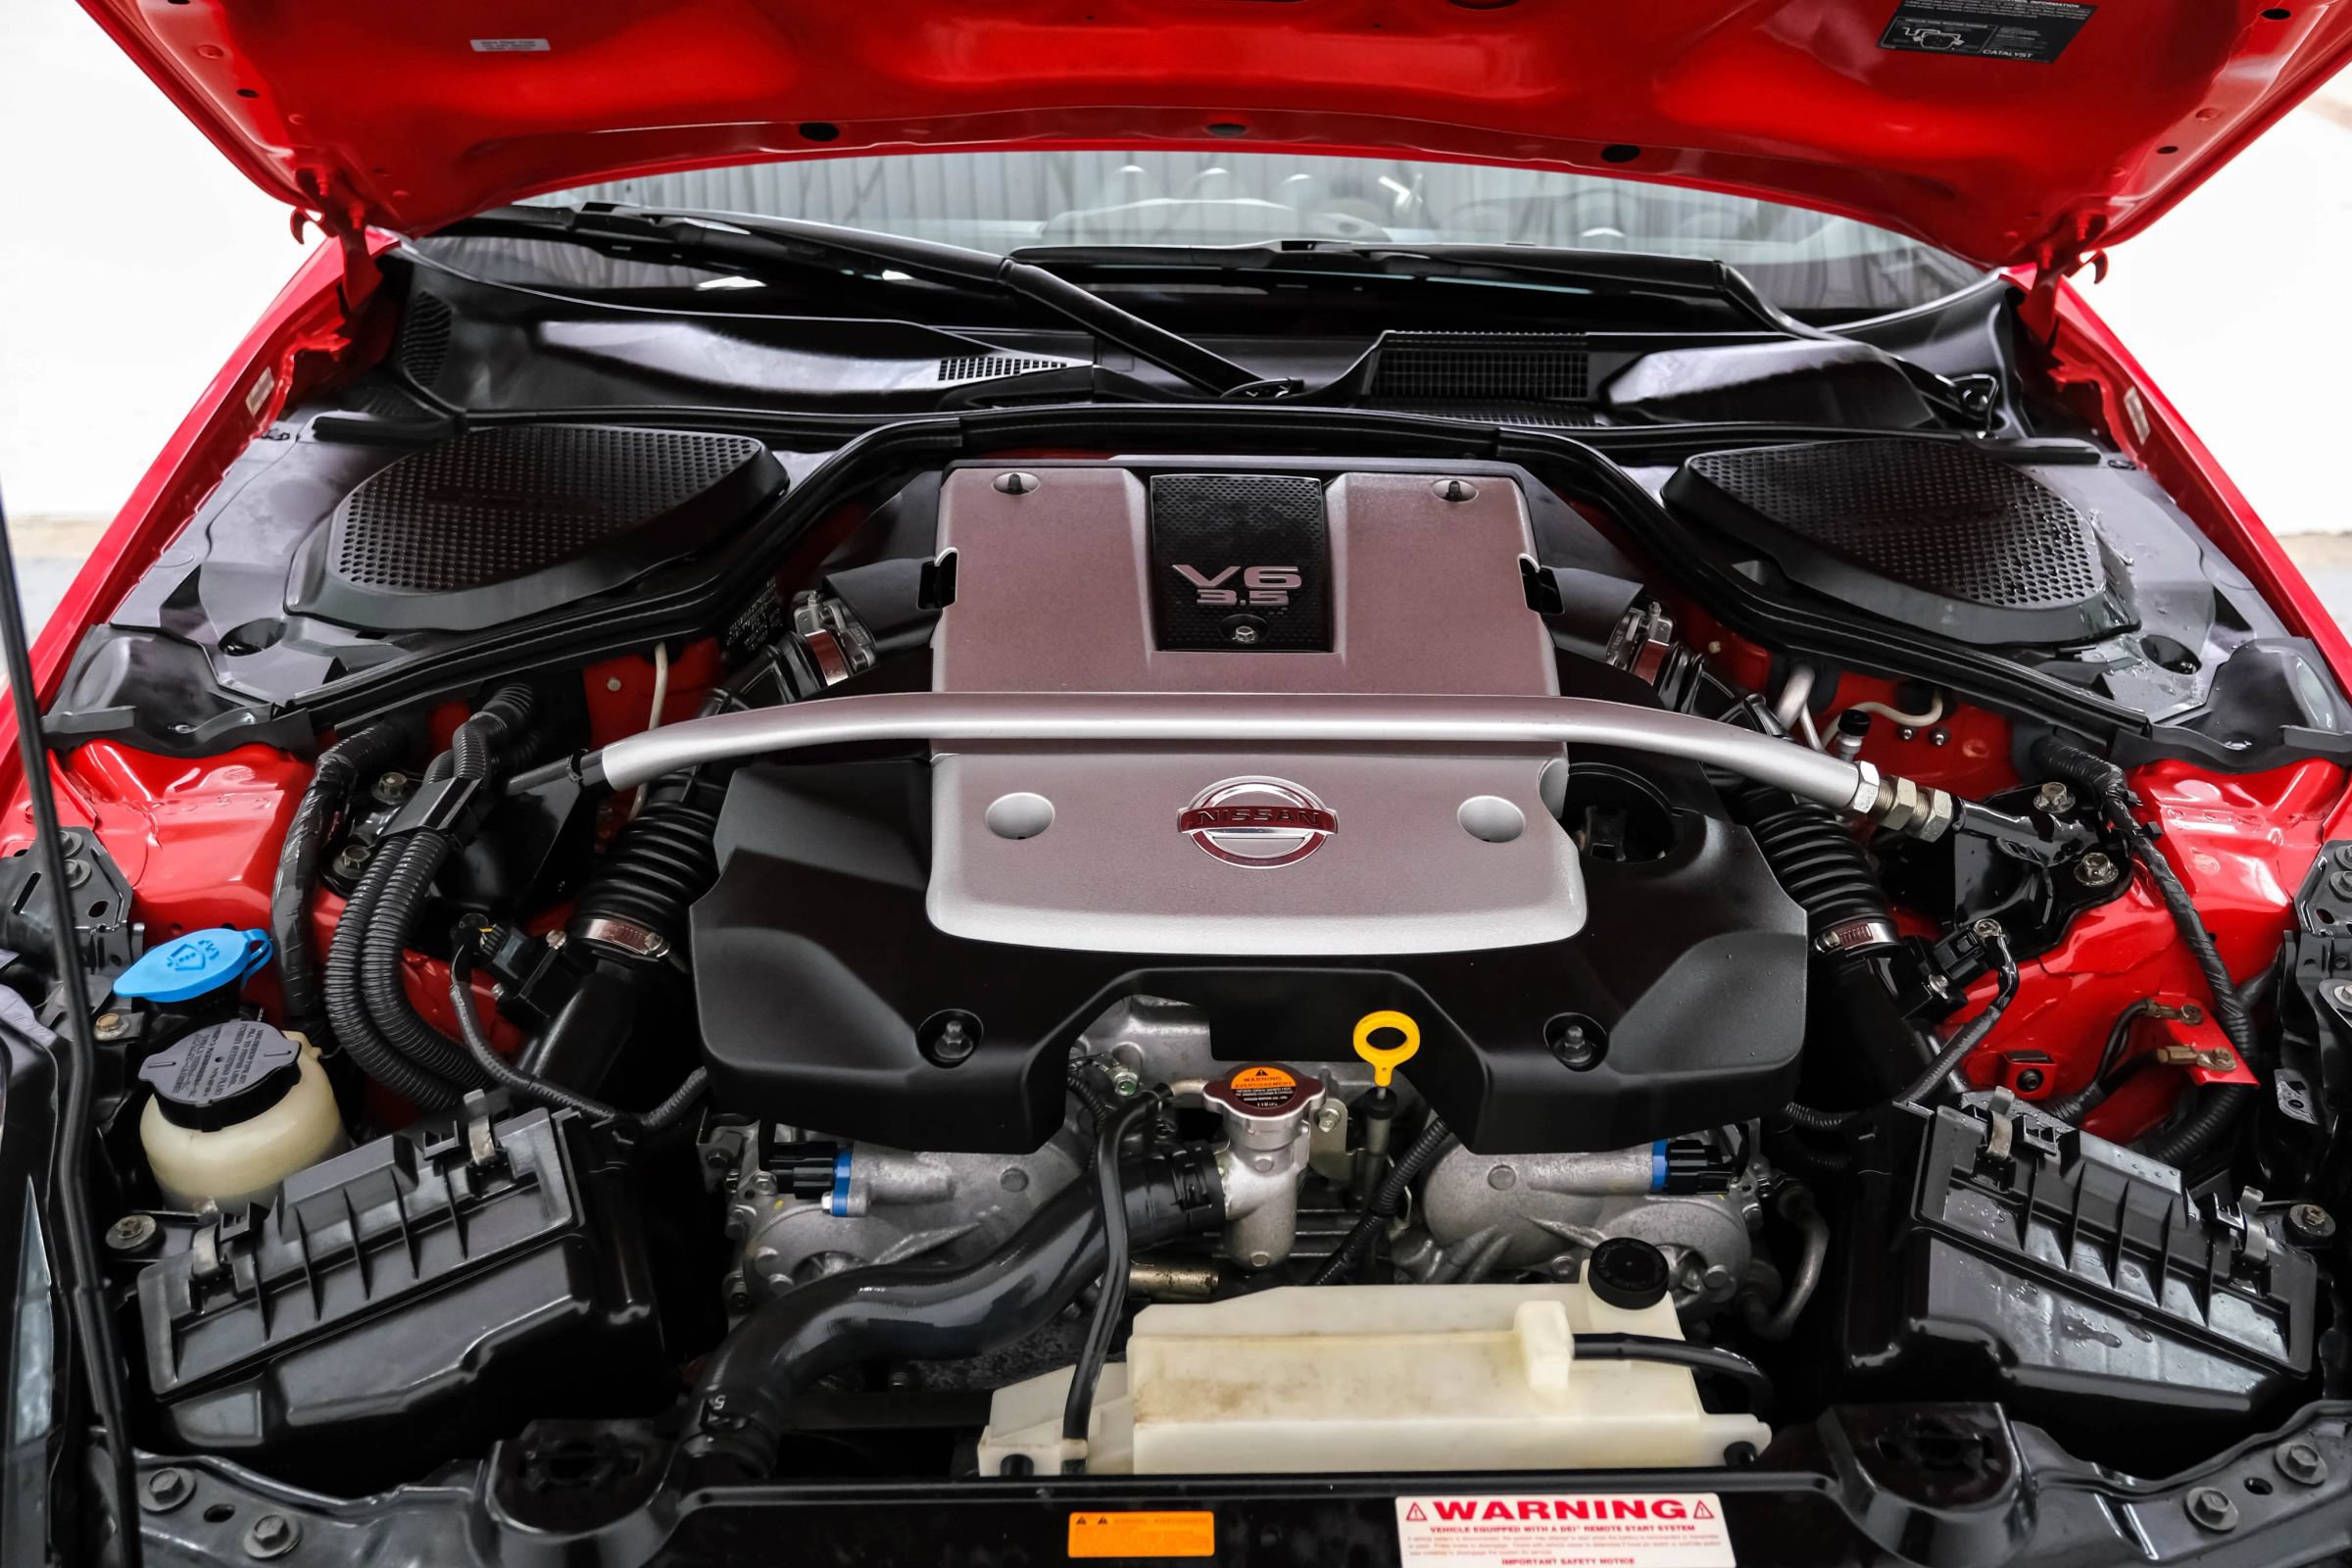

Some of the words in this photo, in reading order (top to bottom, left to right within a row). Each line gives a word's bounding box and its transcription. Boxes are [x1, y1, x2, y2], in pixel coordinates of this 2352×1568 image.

[1983, 49, 2034, 59] CATALYST
[1172, 564, 1301, 589] V6
[1197, 589, 1290, 606] 3.5
[1197, 808, 1319, 824] NISSAN
[1433, 1499, 1687, 1520] WARNING
